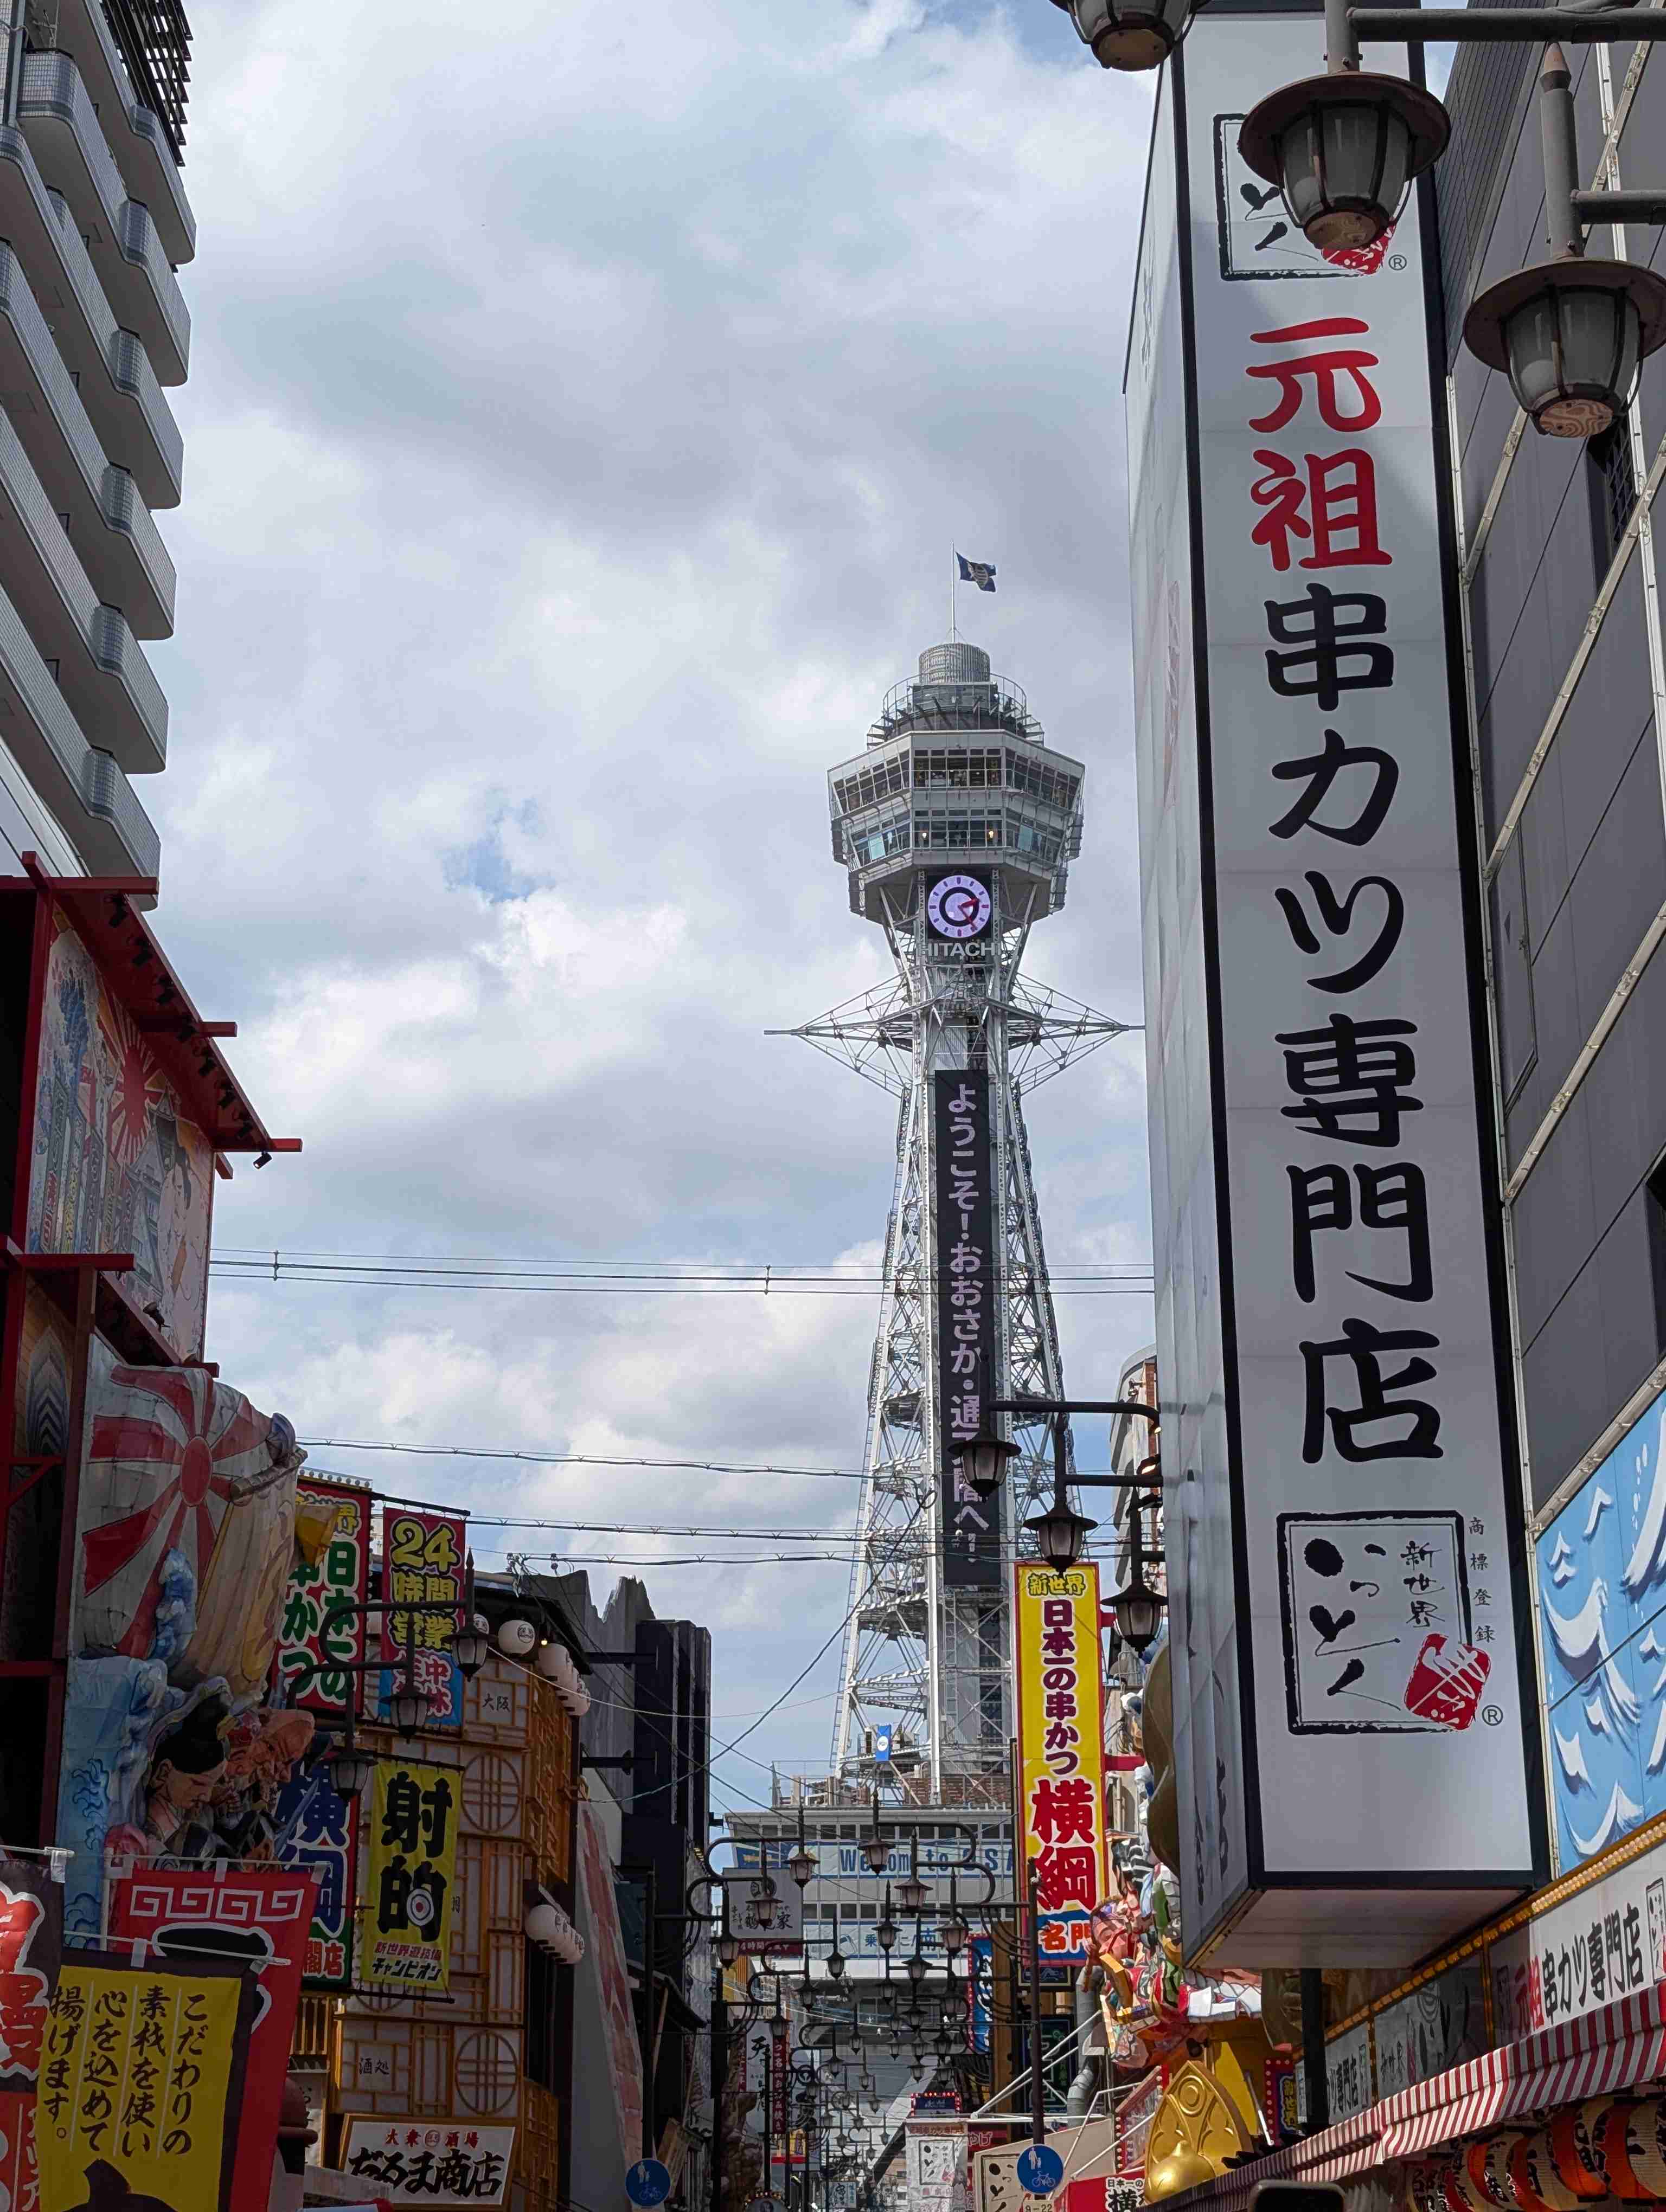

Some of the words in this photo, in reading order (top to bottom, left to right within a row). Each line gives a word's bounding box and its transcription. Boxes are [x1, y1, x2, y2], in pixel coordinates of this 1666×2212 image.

[1250, 318, 1447, 1464] 元祖串カツ専門店
[917, 942, 1001, 956] HITACHI
[392, 1518, 458, 1572] 24
[1028, 1572, 1087, 1596] 新世界
[1400, 1540, 1445, 1627] 新世界
[1469, 1516, 1496, 1643] 商標登録
[483, 1693, 511, 1712] 大阪
[1041, 1599, 1079, 1775] 日本一の串かつ
[377, 1771, 453, 1943] 射的
[1030, 1778, 1098, 1911] 横綱
[373, 1958, 443, 1981] チャンピオン
[42, 1985, 87, 2142] 揚げます。
[79, 1990, 128, 2152] 心を込めて
[120, 1984, 172, 2158] 素材を使い
[163, 1994, 209, 2155] こだわりの
[359, 2058, 389, 2075] 酒処
[385, 2129, 421, 2147] 大衆
[1108, 2178, 1143, 2188] 日本一の
